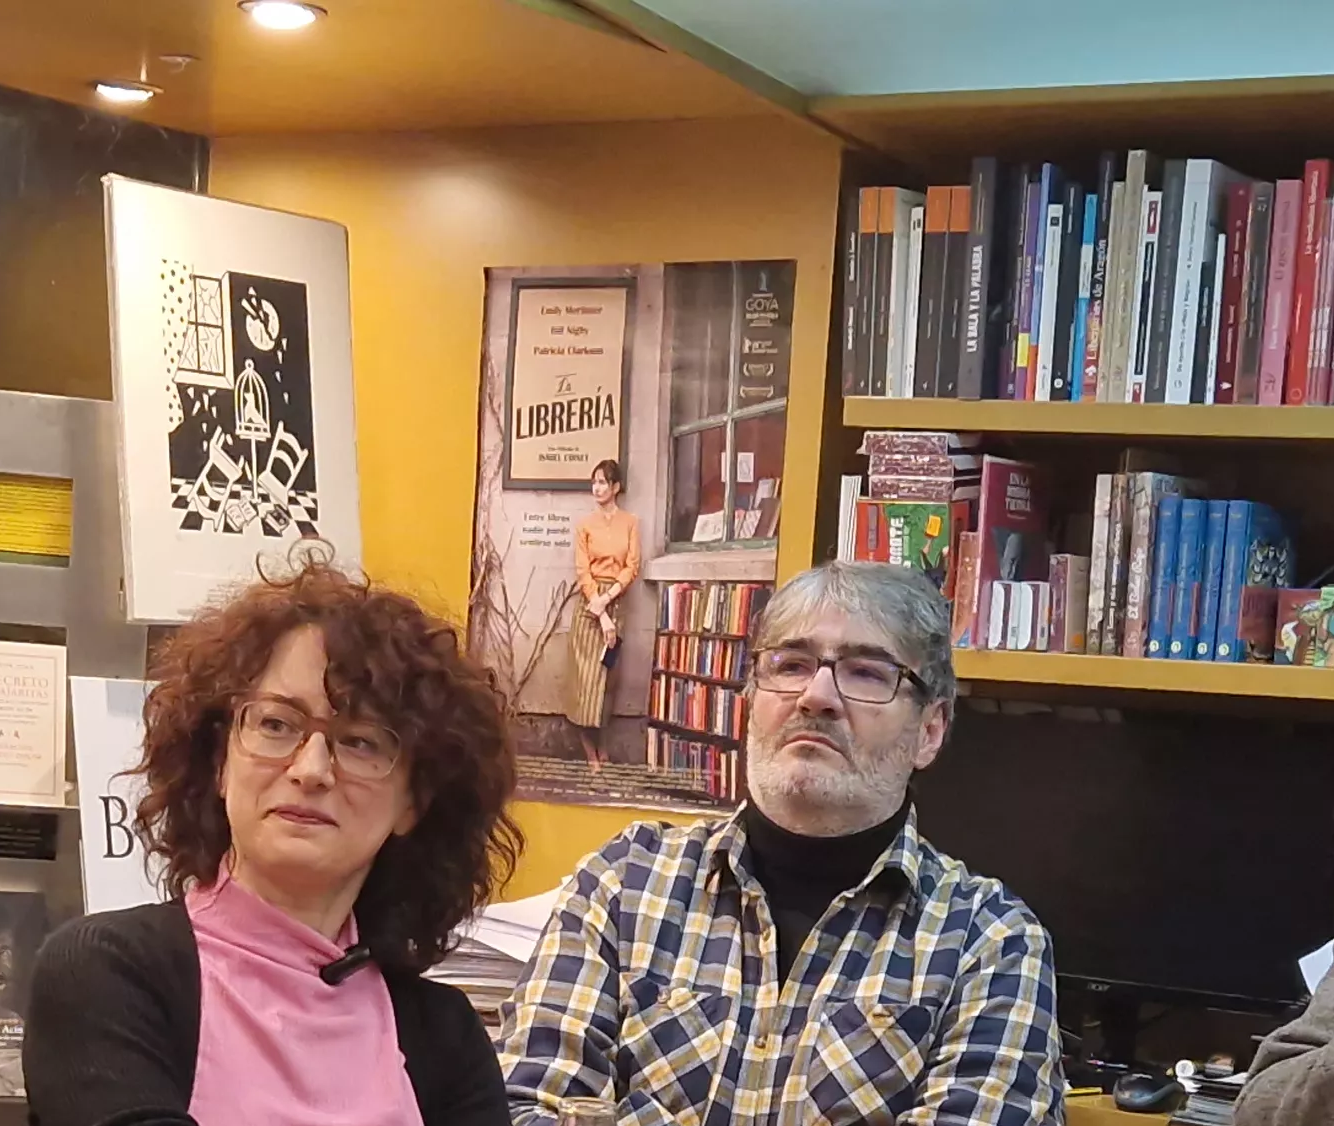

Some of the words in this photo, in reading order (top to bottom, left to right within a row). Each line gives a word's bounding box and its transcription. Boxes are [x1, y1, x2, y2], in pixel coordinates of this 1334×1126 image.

[1093, 239, 1108, 282] Aragón
[969, 289, 981, 302] LA
[1092, 282, 1104, 297] de
[745, 298, 779, 311] GOYA
[966, 340, 979, 353] LA
[516, 386, 615, 440] LIBRERÍA
